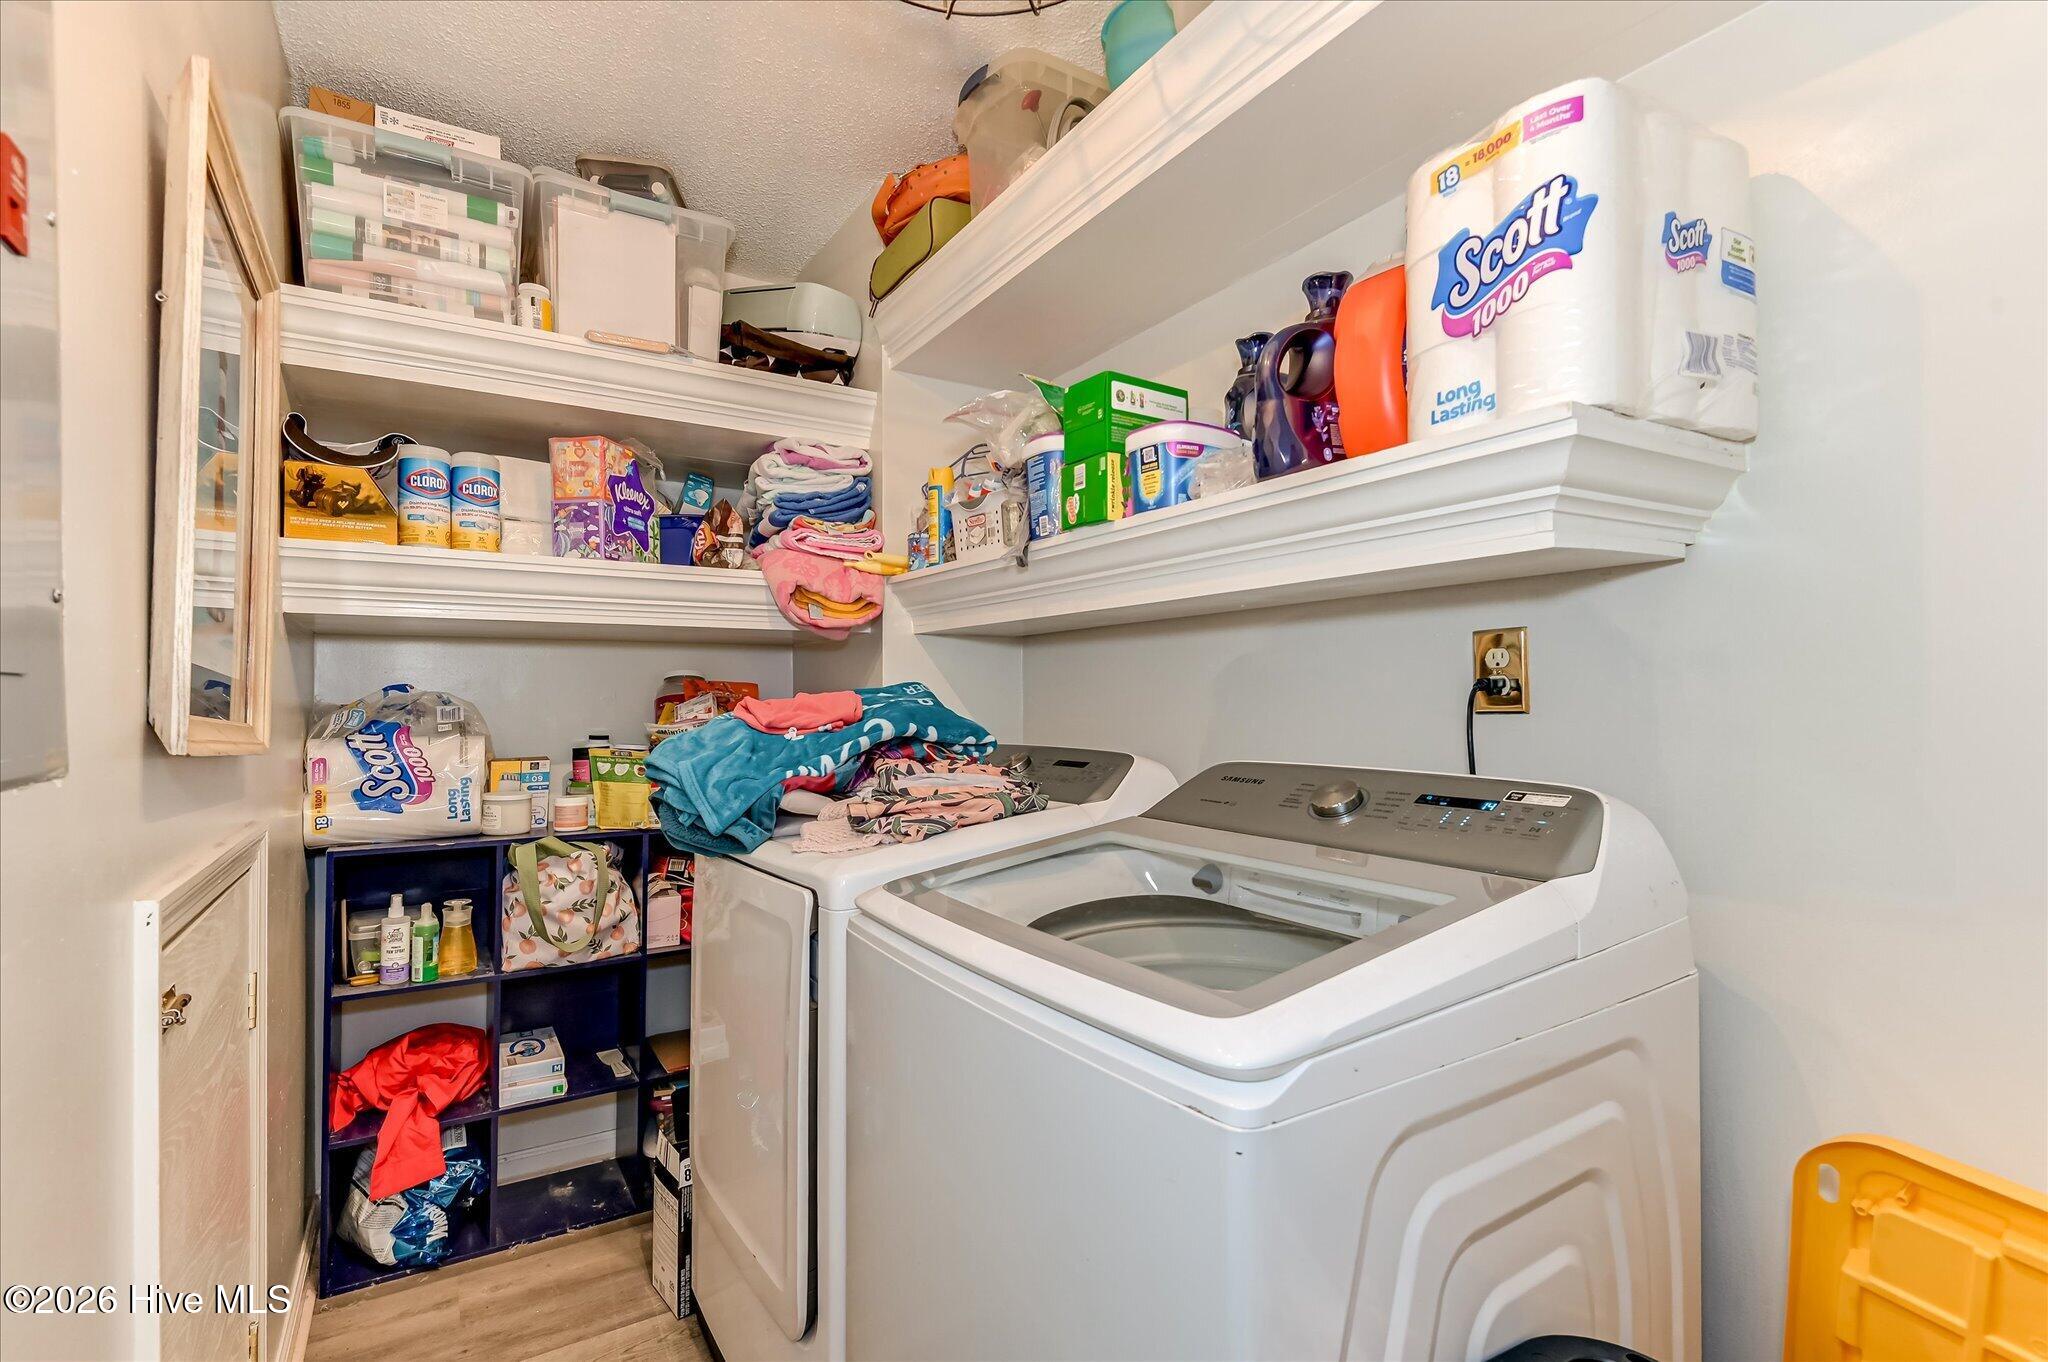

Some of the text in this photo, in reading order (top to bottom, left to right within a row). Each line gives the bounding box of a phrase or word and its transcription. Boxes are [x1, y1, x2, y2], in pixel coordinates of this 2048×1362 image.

[333, 98, 351, 110] 1855
[1549, 103, 1571, 116] Over
[1437, 164, 1460, 194] 18
[1448, 174, 1571, 309] Scott
[1667, 218, 1708, 254] Scott
[1676, 255, 1697, 273] 1000
[1472, 269, 1529, 338] 1000
[1436, 380, 1481, 406] Long
[1430, 393, 1496, 425] Lasting
[410, 475, 448, 490] CLOROX
[462, 483, 498, 498] CLOROX
[614, 481, 651, 510] Kleenex
[345, 731, 411, 801] Scott
[403, 747, 436, 783] 1000
[1220, 775, 1266, 785] SAMSUNG
[447, 788, 461, 820] Long
[460, 776, 472, 823] Lasting
[1481, 801, 1498, 811] 14
[315, 816, 329, 831] 18
[554, 1064, 561, 1072] M
[684, 1168, 691, 1182] 8
